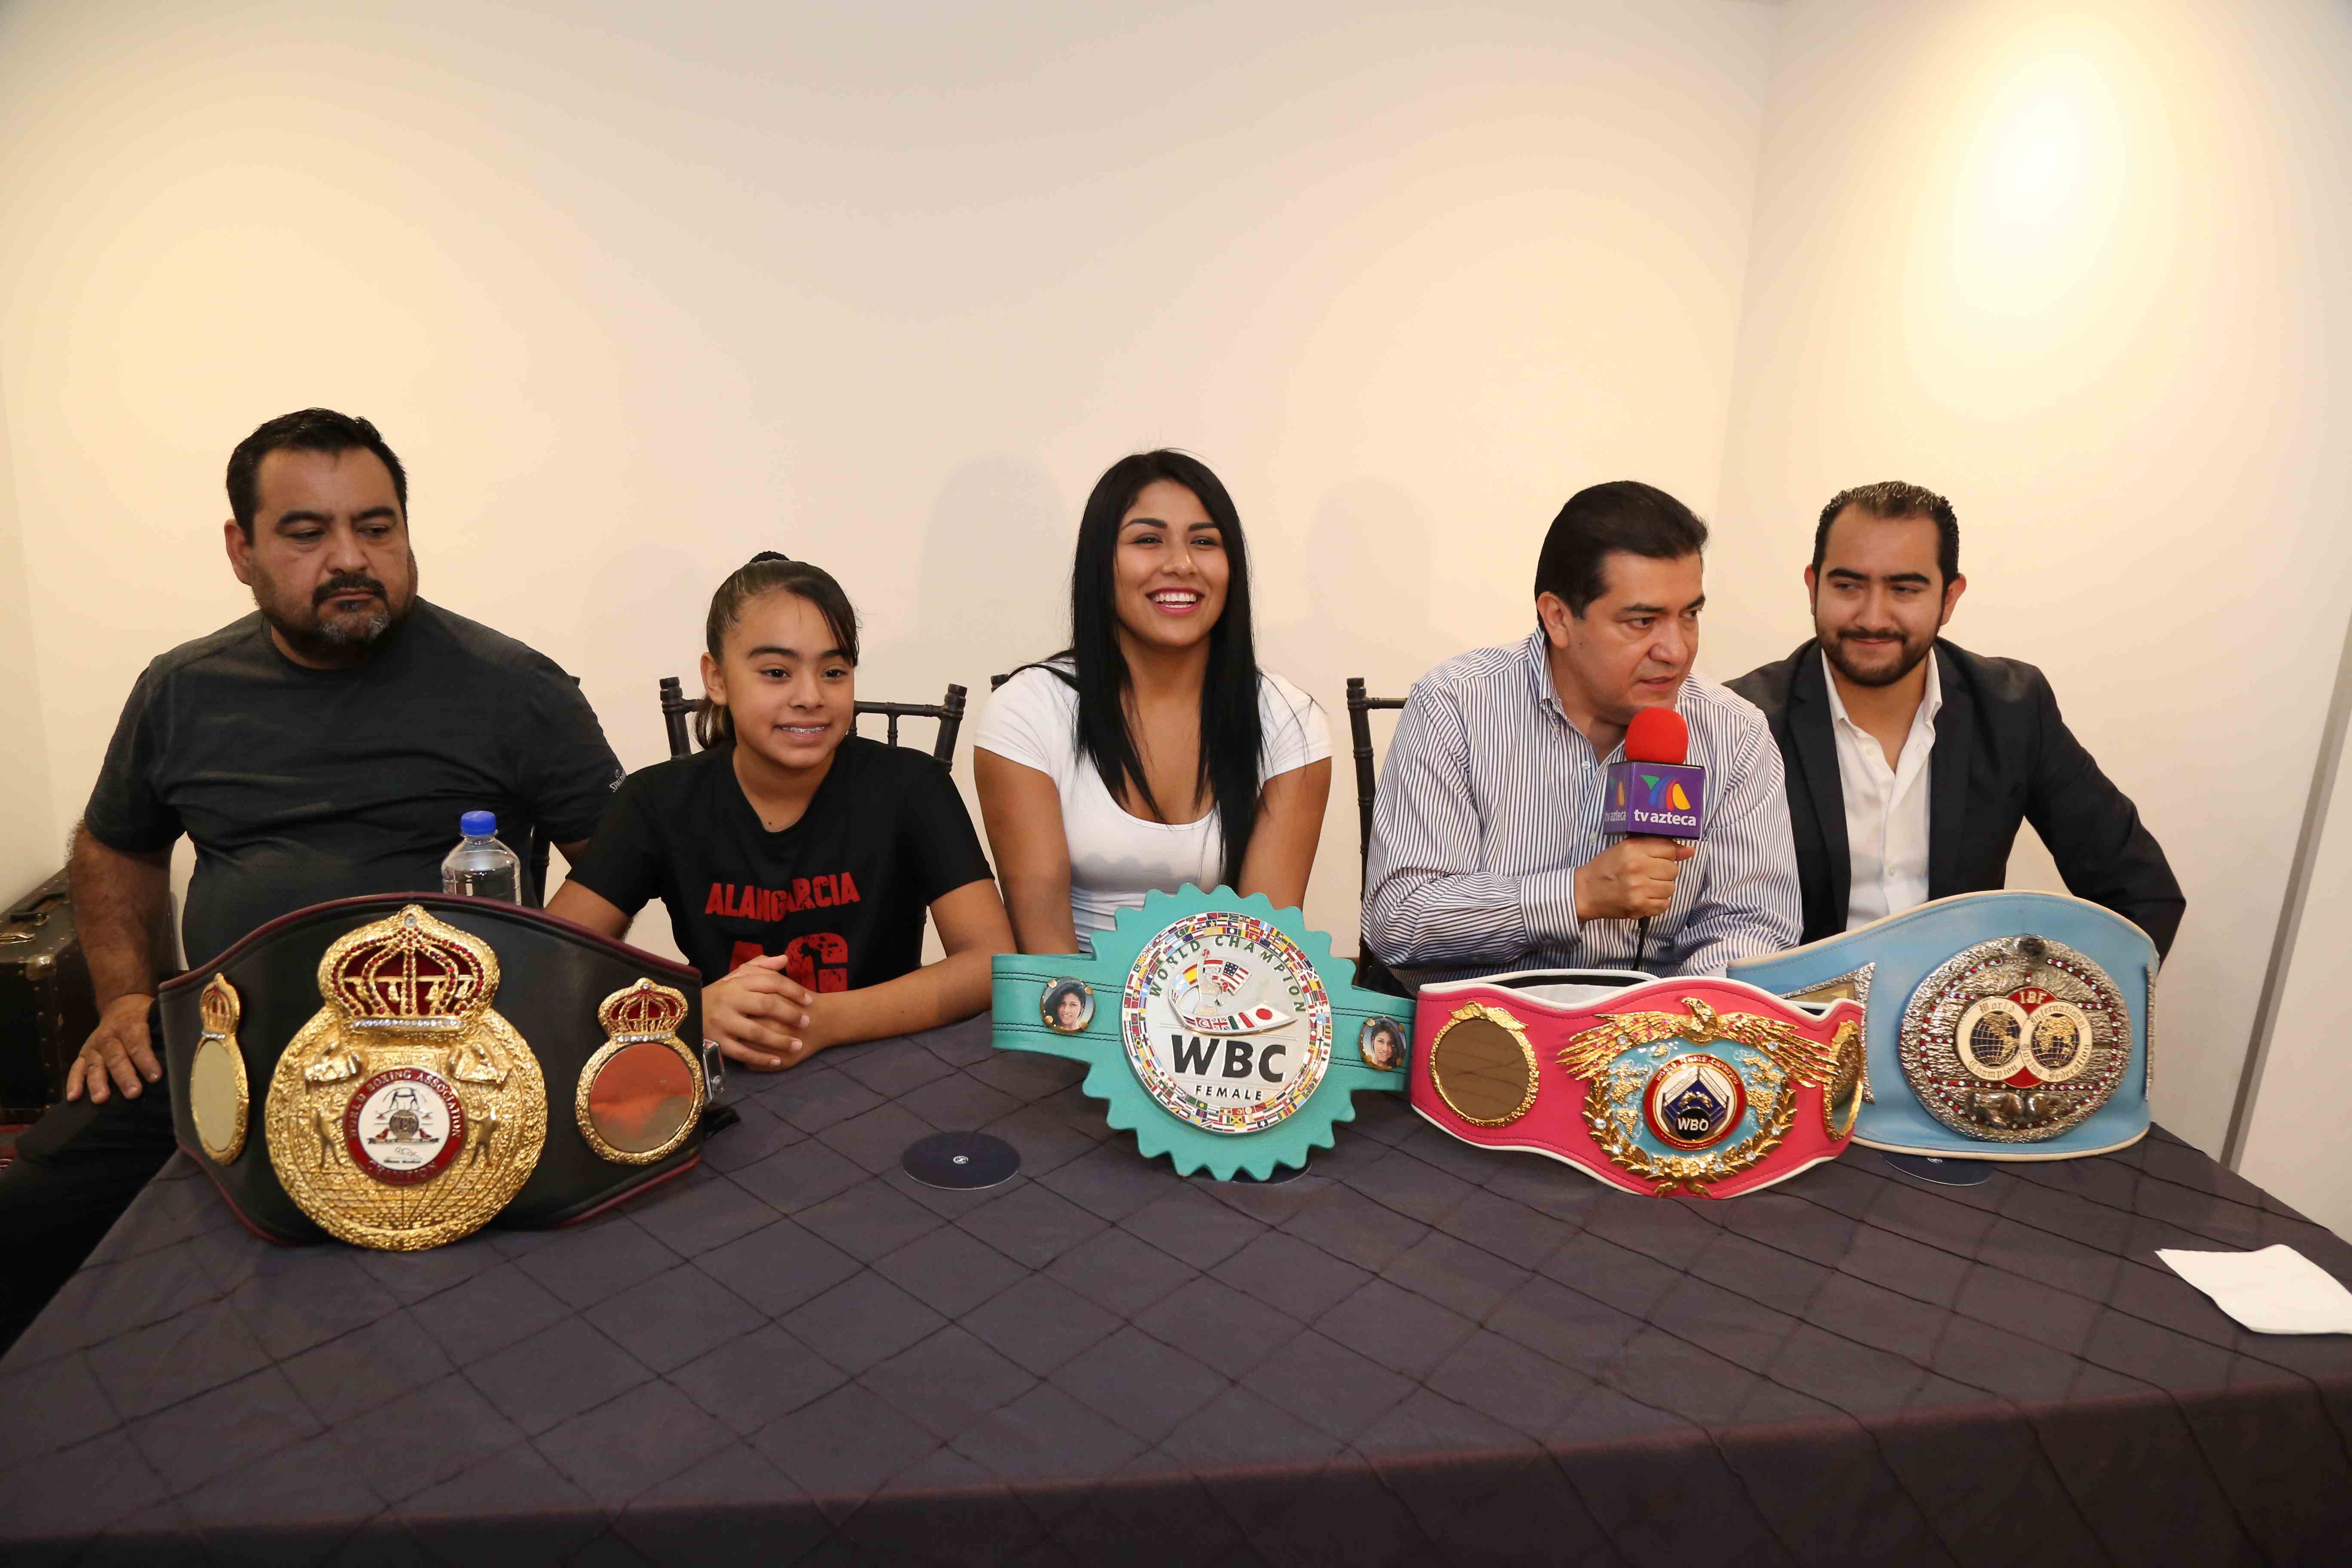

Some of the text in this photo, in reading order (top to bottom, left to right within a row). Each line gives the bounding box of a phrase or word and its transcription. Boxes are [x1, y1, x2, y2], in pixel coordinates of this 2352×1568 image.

[1634, 809, 1697, 826] tv azteca
[1149, 935, 1305, 1012] WORLD CHAMPION
[1979, 1001, 2015, 1013] World
[2020, 990, 2047, 1004] IBF
[2030, 1005, 2088, 1031] International
[1171, 1034, 1286, 1083] WBC
[2047, 1044, 2092, 1081] Federation
[1968, 1060, 2018, 1080] Champion
[1195, 1084, 1263, 1101] FEMALE
[347, 1069, 462, 1138] WORLD BOXING ASSOCIATION
[1677, 1117, 1709, 1132] WBO
